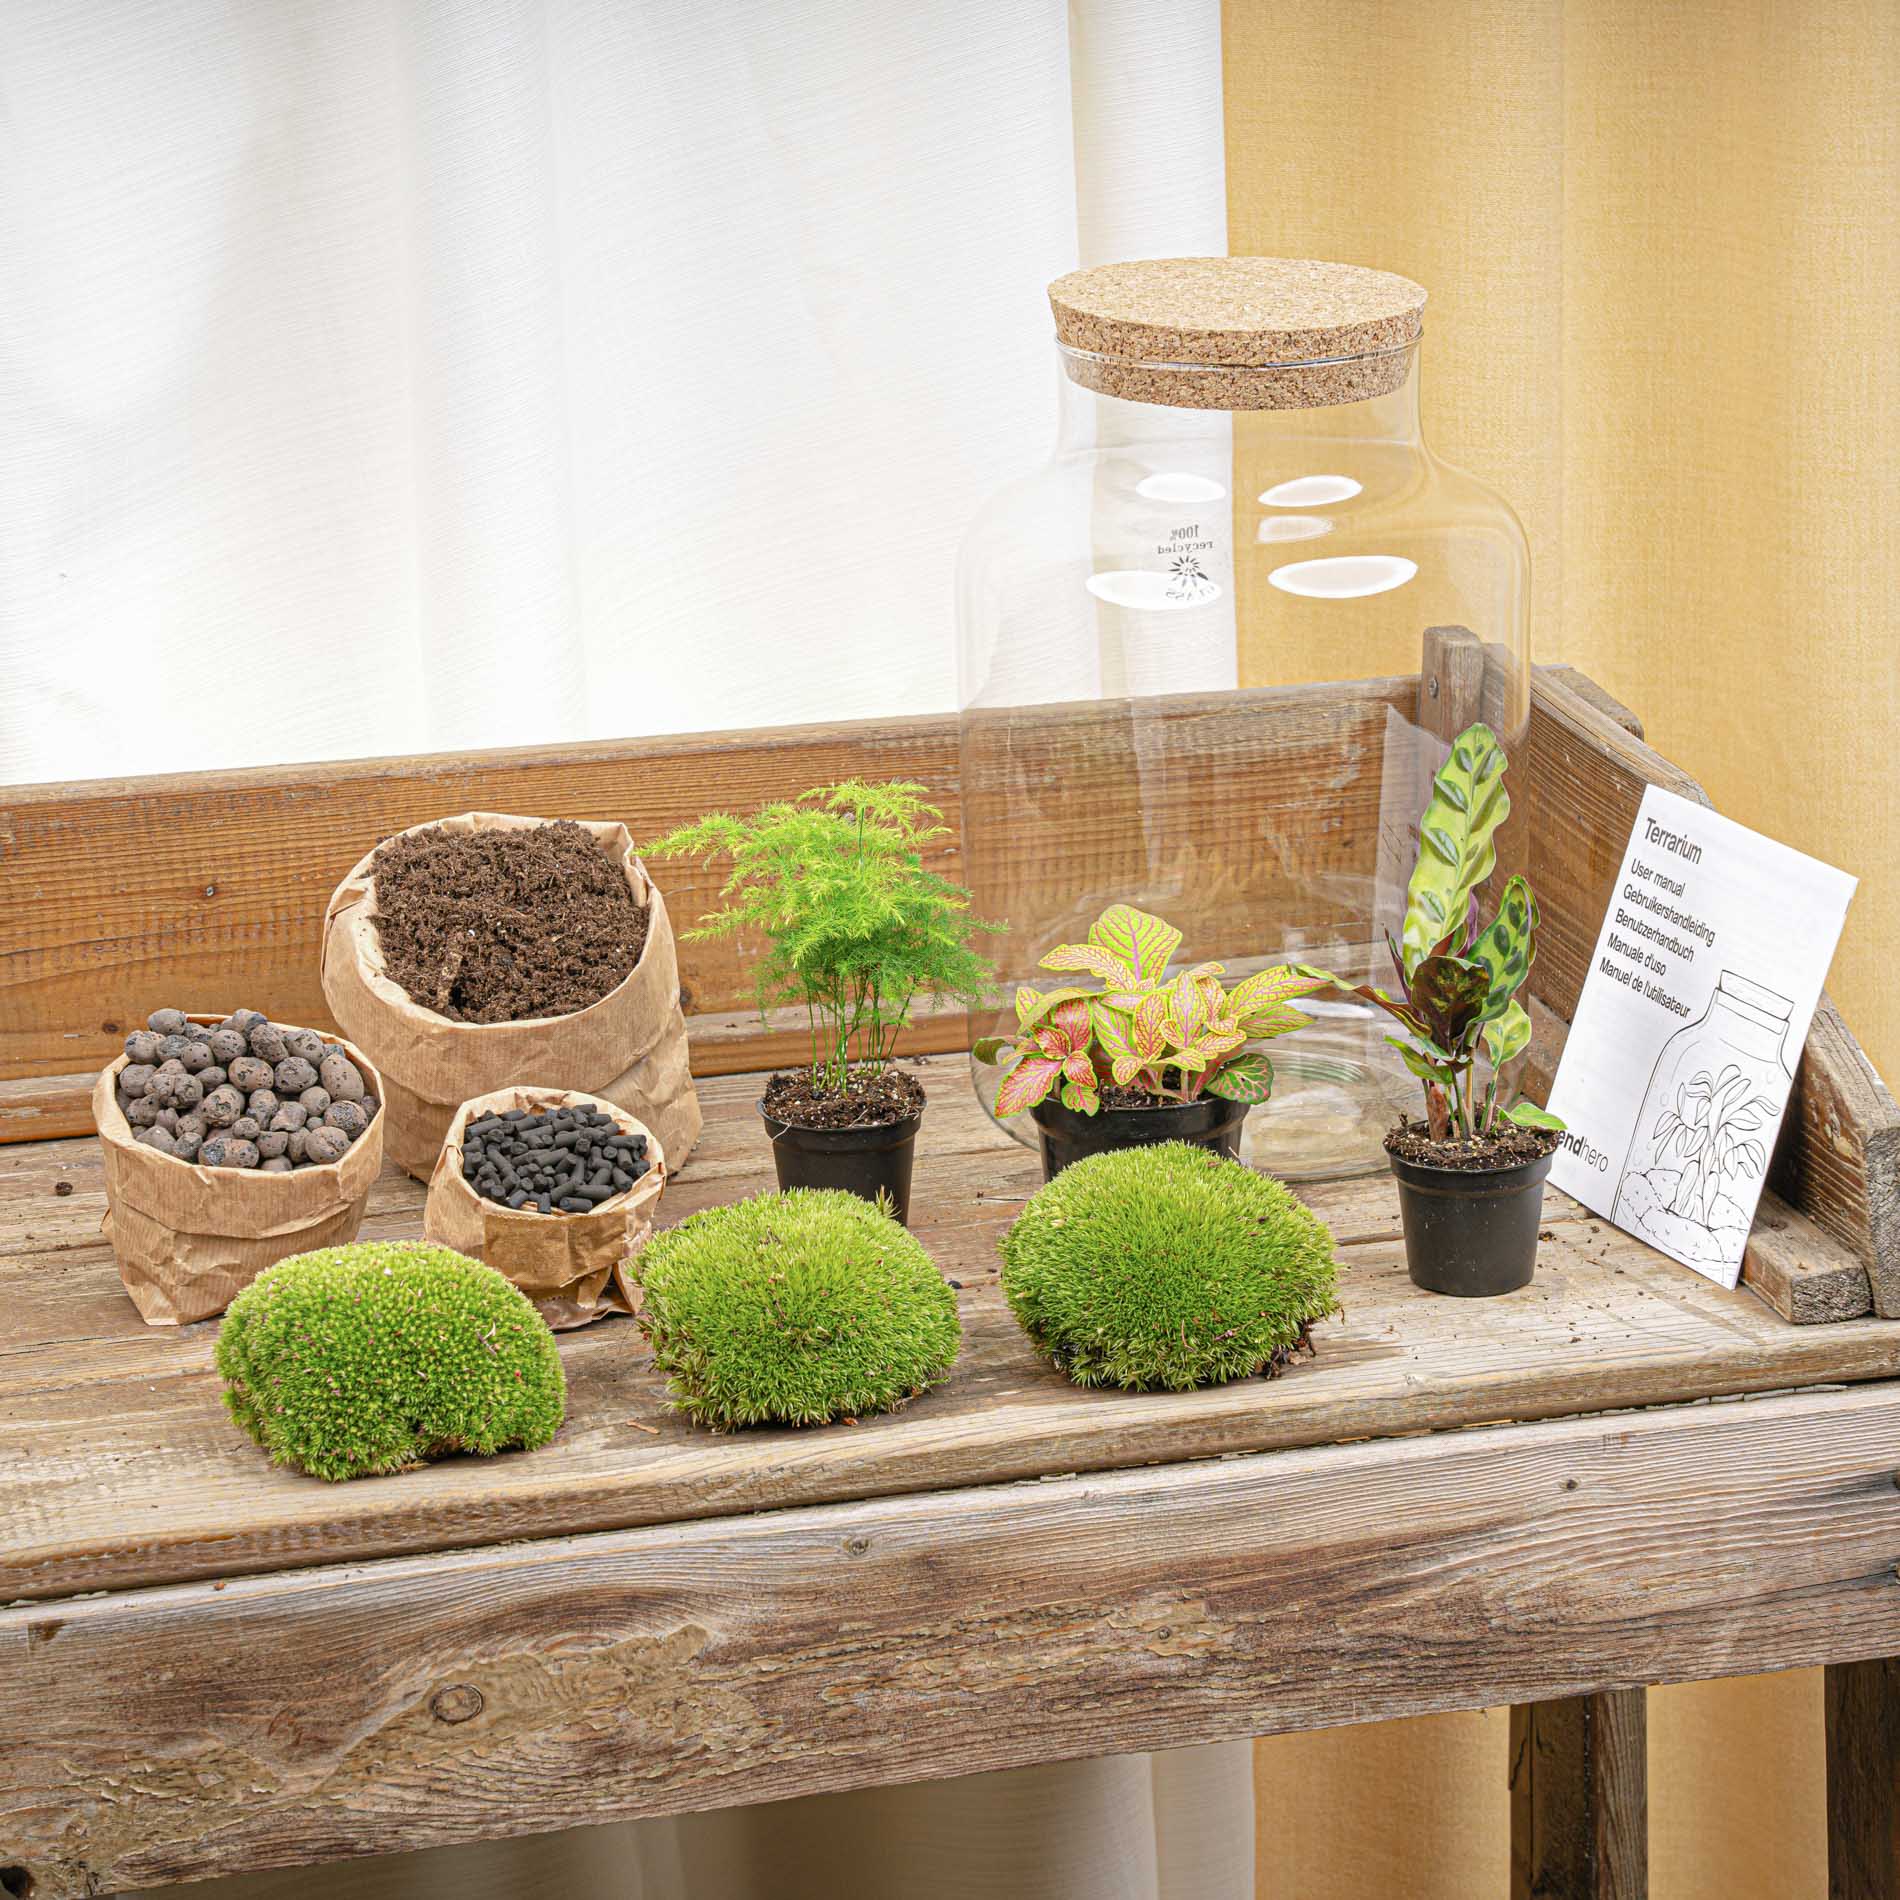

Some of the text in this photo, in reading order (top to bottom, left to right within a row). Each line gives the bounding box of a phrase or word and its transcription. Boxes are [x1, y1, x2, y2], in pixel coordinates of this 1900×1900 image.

[1644, 817, 1702, 864] Terrarium
[1630, 858, 1686, 898] User manual
[1615, 908, 1694, 962] Benutzerhandbuch
[1623, 884, 1715, 947] Gebruikershandleiding
[1607, 932, 1667, 976] Manuale d'uso
[1599, 957, 1691, 1018] Manuel de l'utilisateur
